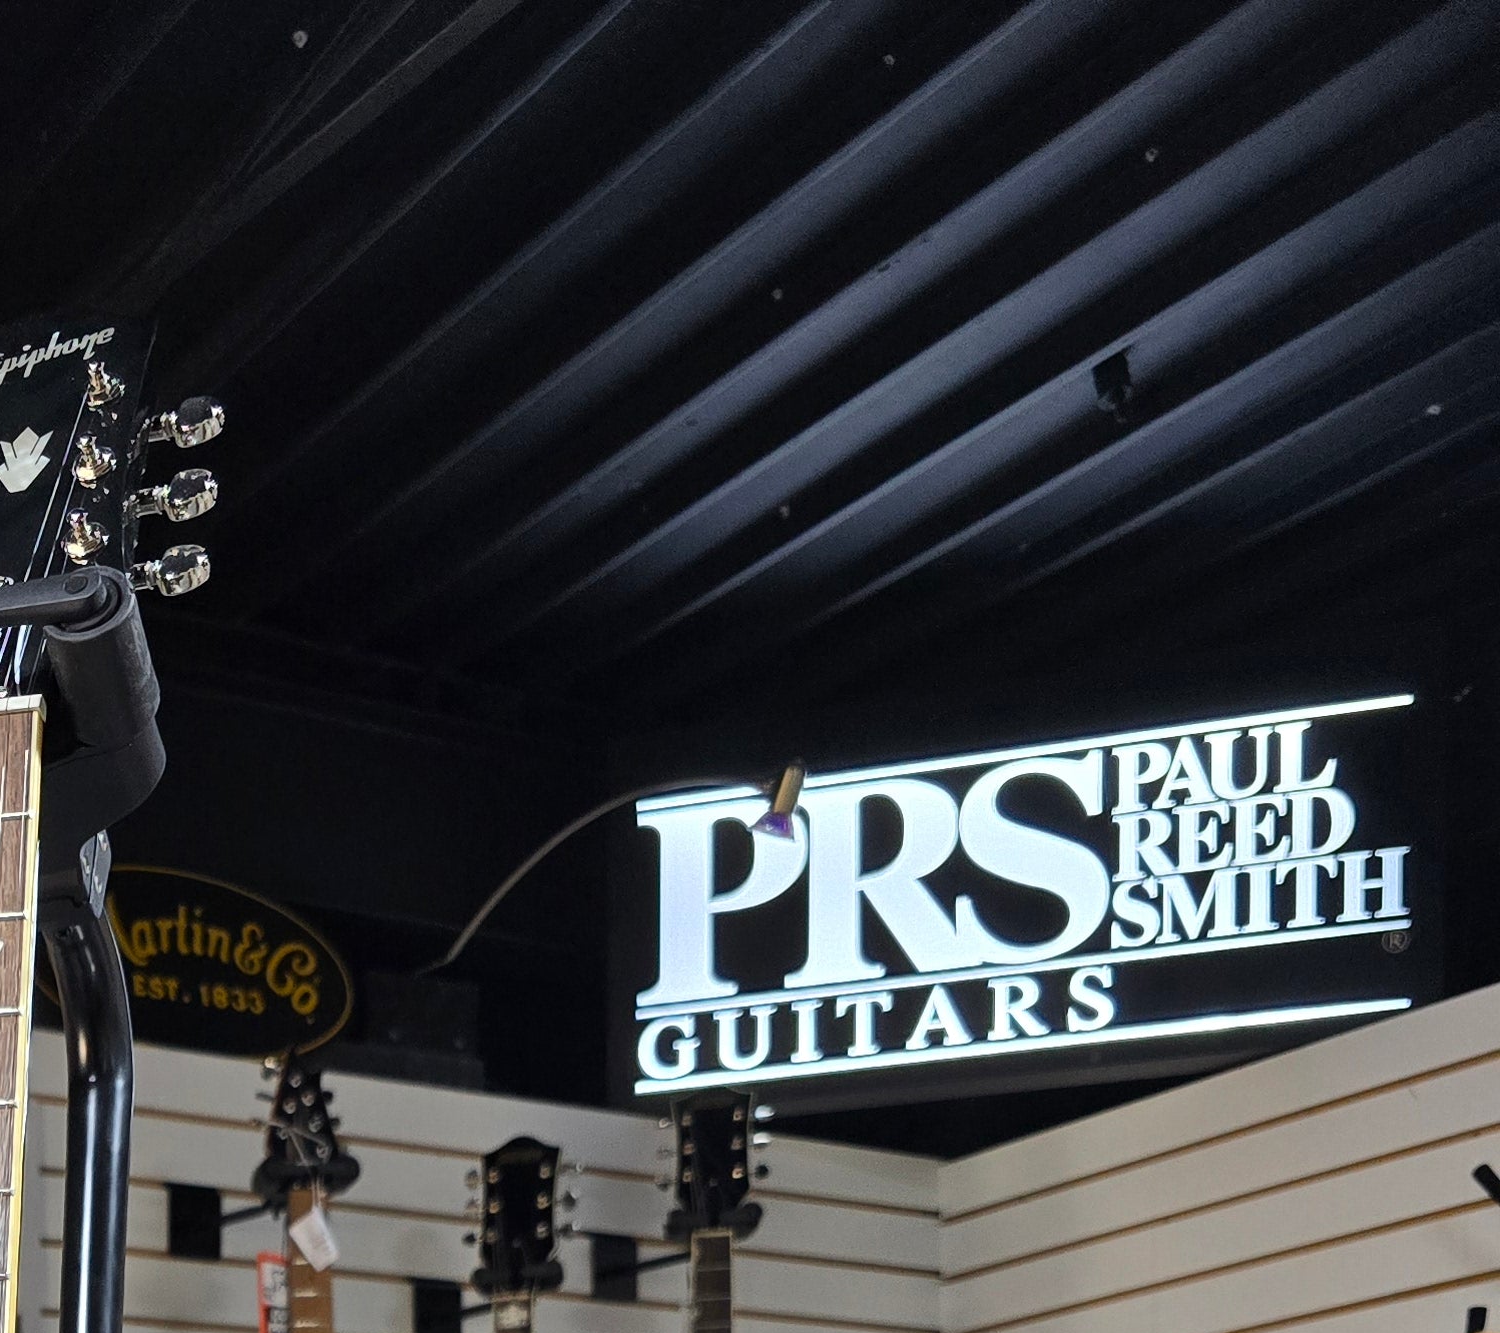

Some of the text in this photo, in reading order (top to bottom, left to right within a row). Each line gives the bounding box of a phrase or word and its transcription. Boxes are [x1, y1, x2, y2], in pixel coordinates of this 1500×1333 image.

[1110, 721, 1338, 816] PAUL
[636, 748, 1111, 1007] PRS
[1111, 787, 1357, 883] REED
[1110, 845, 1411, 950] SMITH
[201, 984, 265, 1016] 1833
[637, 965, 1116, 1081] GUITARS
